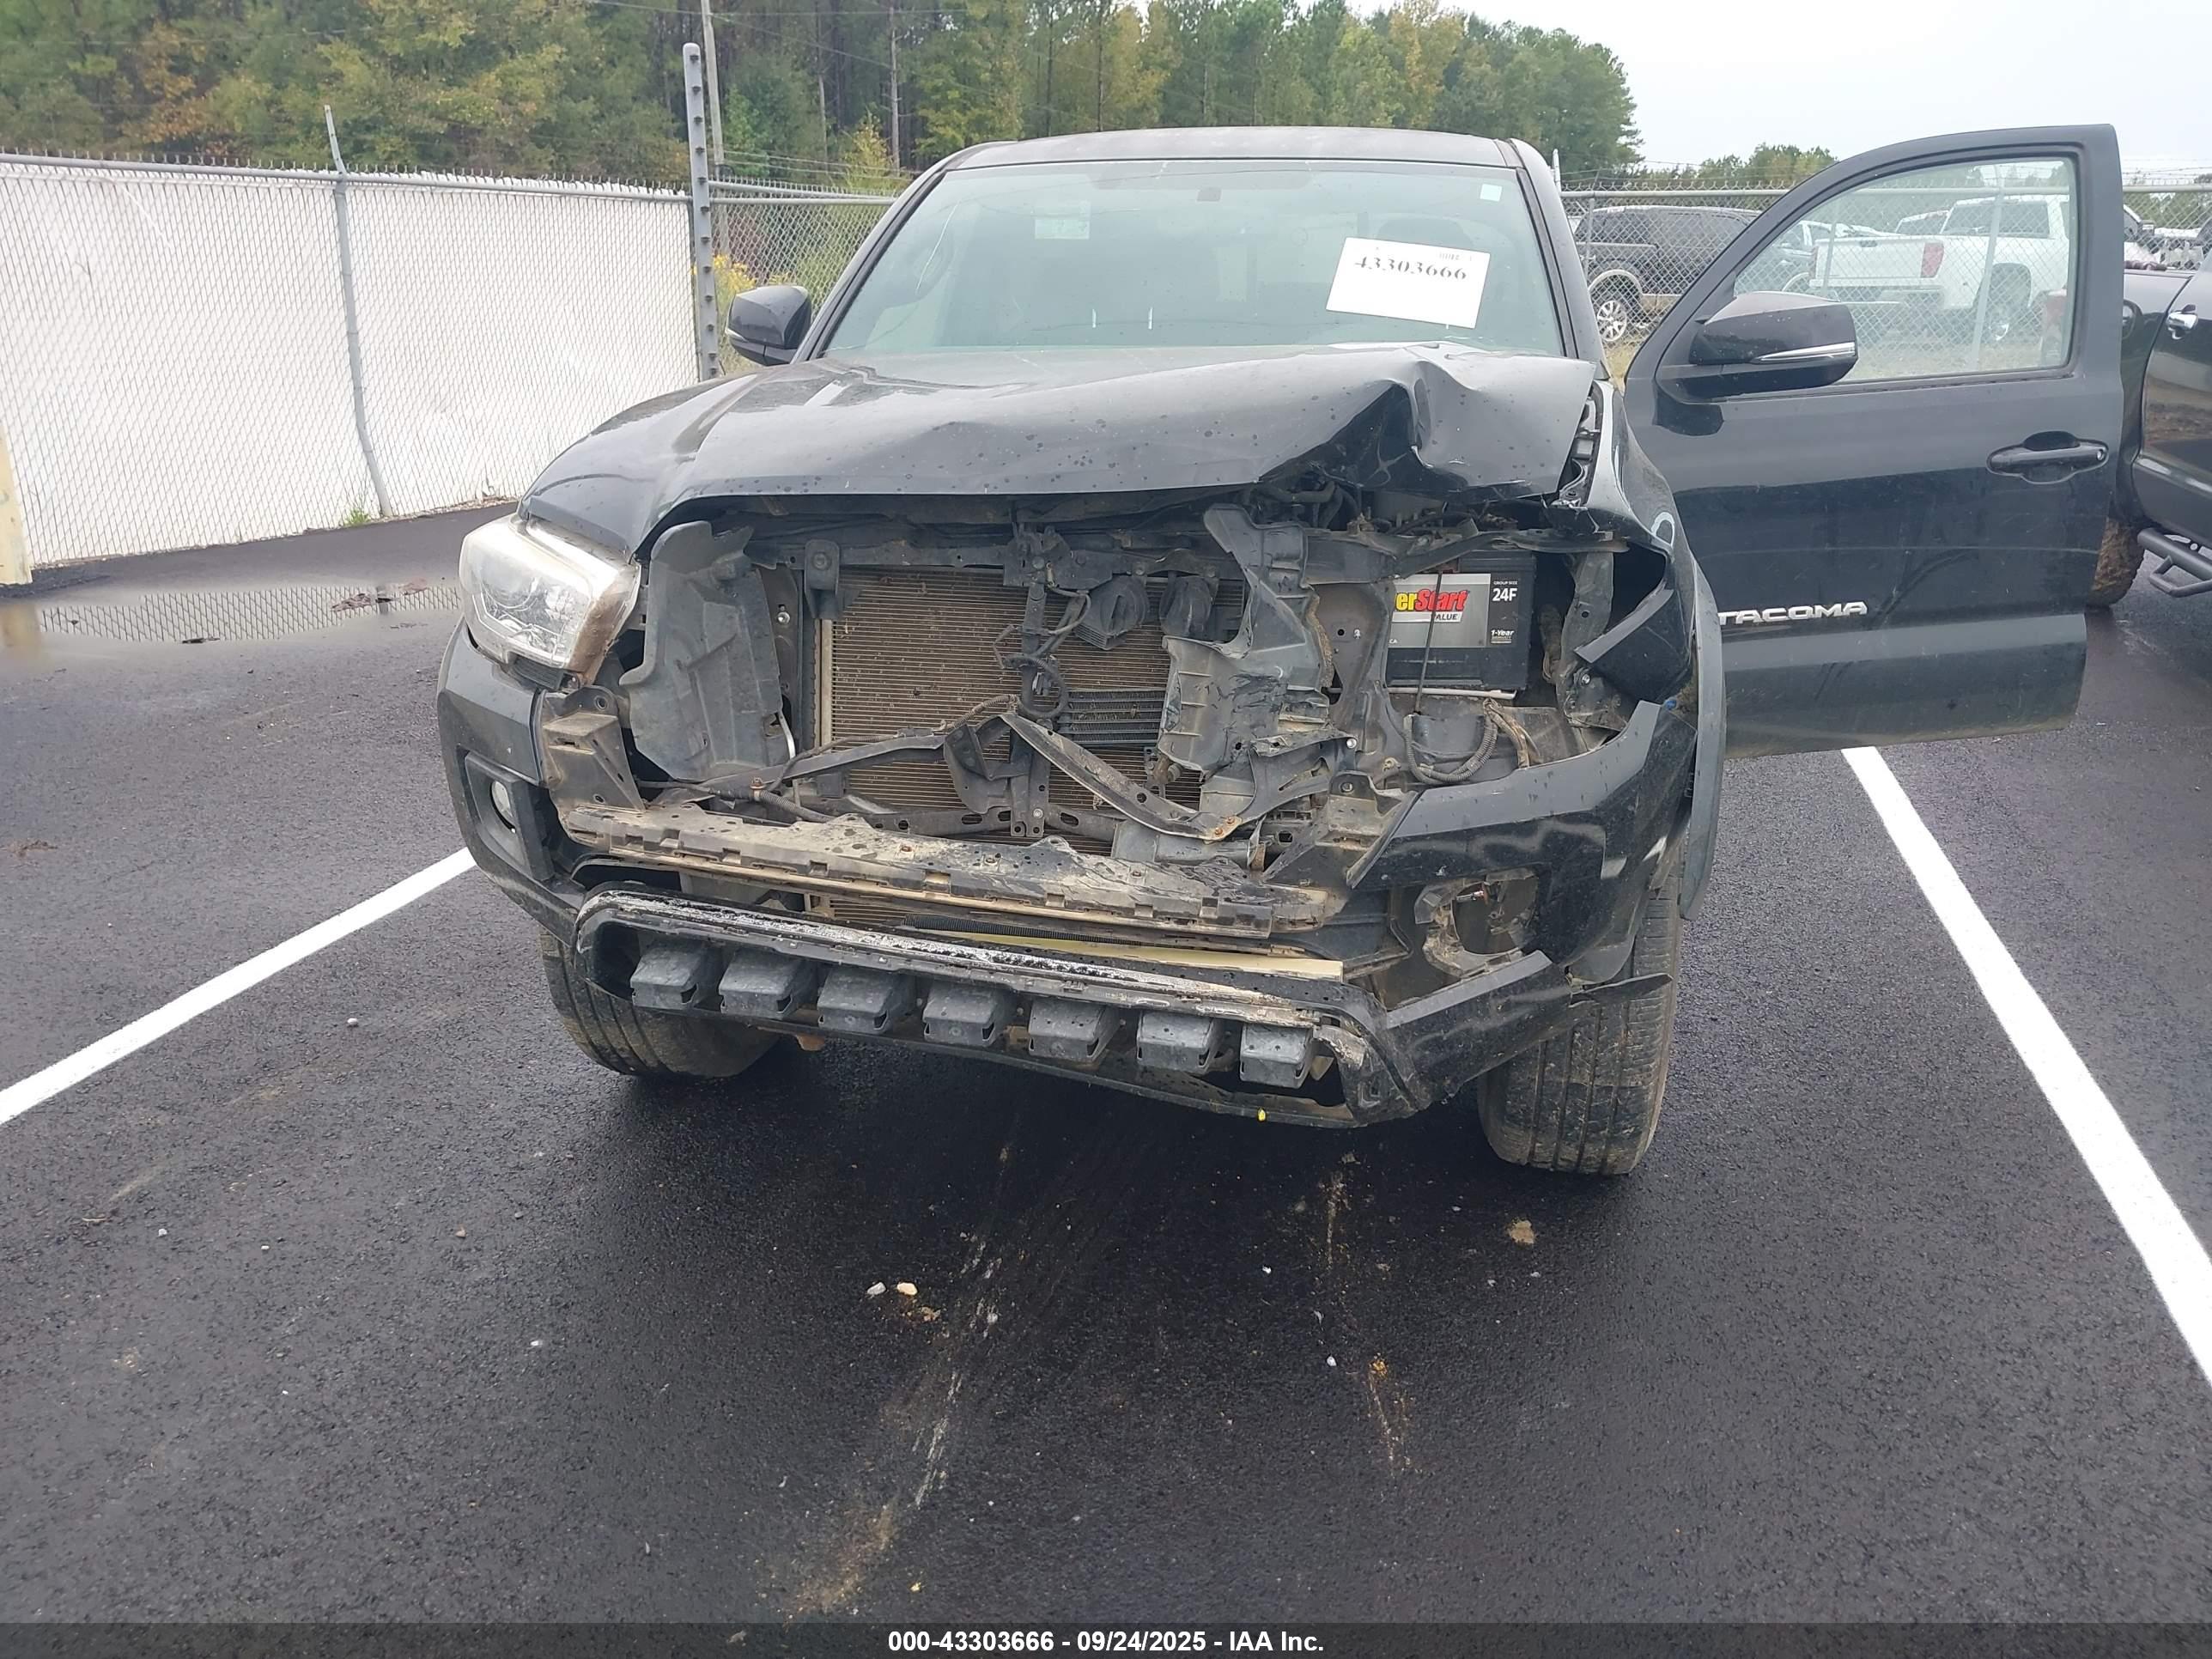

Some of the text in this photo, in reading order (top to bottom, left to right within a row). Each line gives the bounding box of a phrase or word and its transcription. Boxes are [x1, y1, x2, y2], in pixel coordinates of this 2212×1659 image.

[1354, 255, 1467, 280] 43303666
[1395, 588, 1468, 611] erStart
[1492, 587, 1517, 601] 24F
[1434, 612, 1459, 622] ALUE
[1717, 601, 1869, 625] TACOMA
